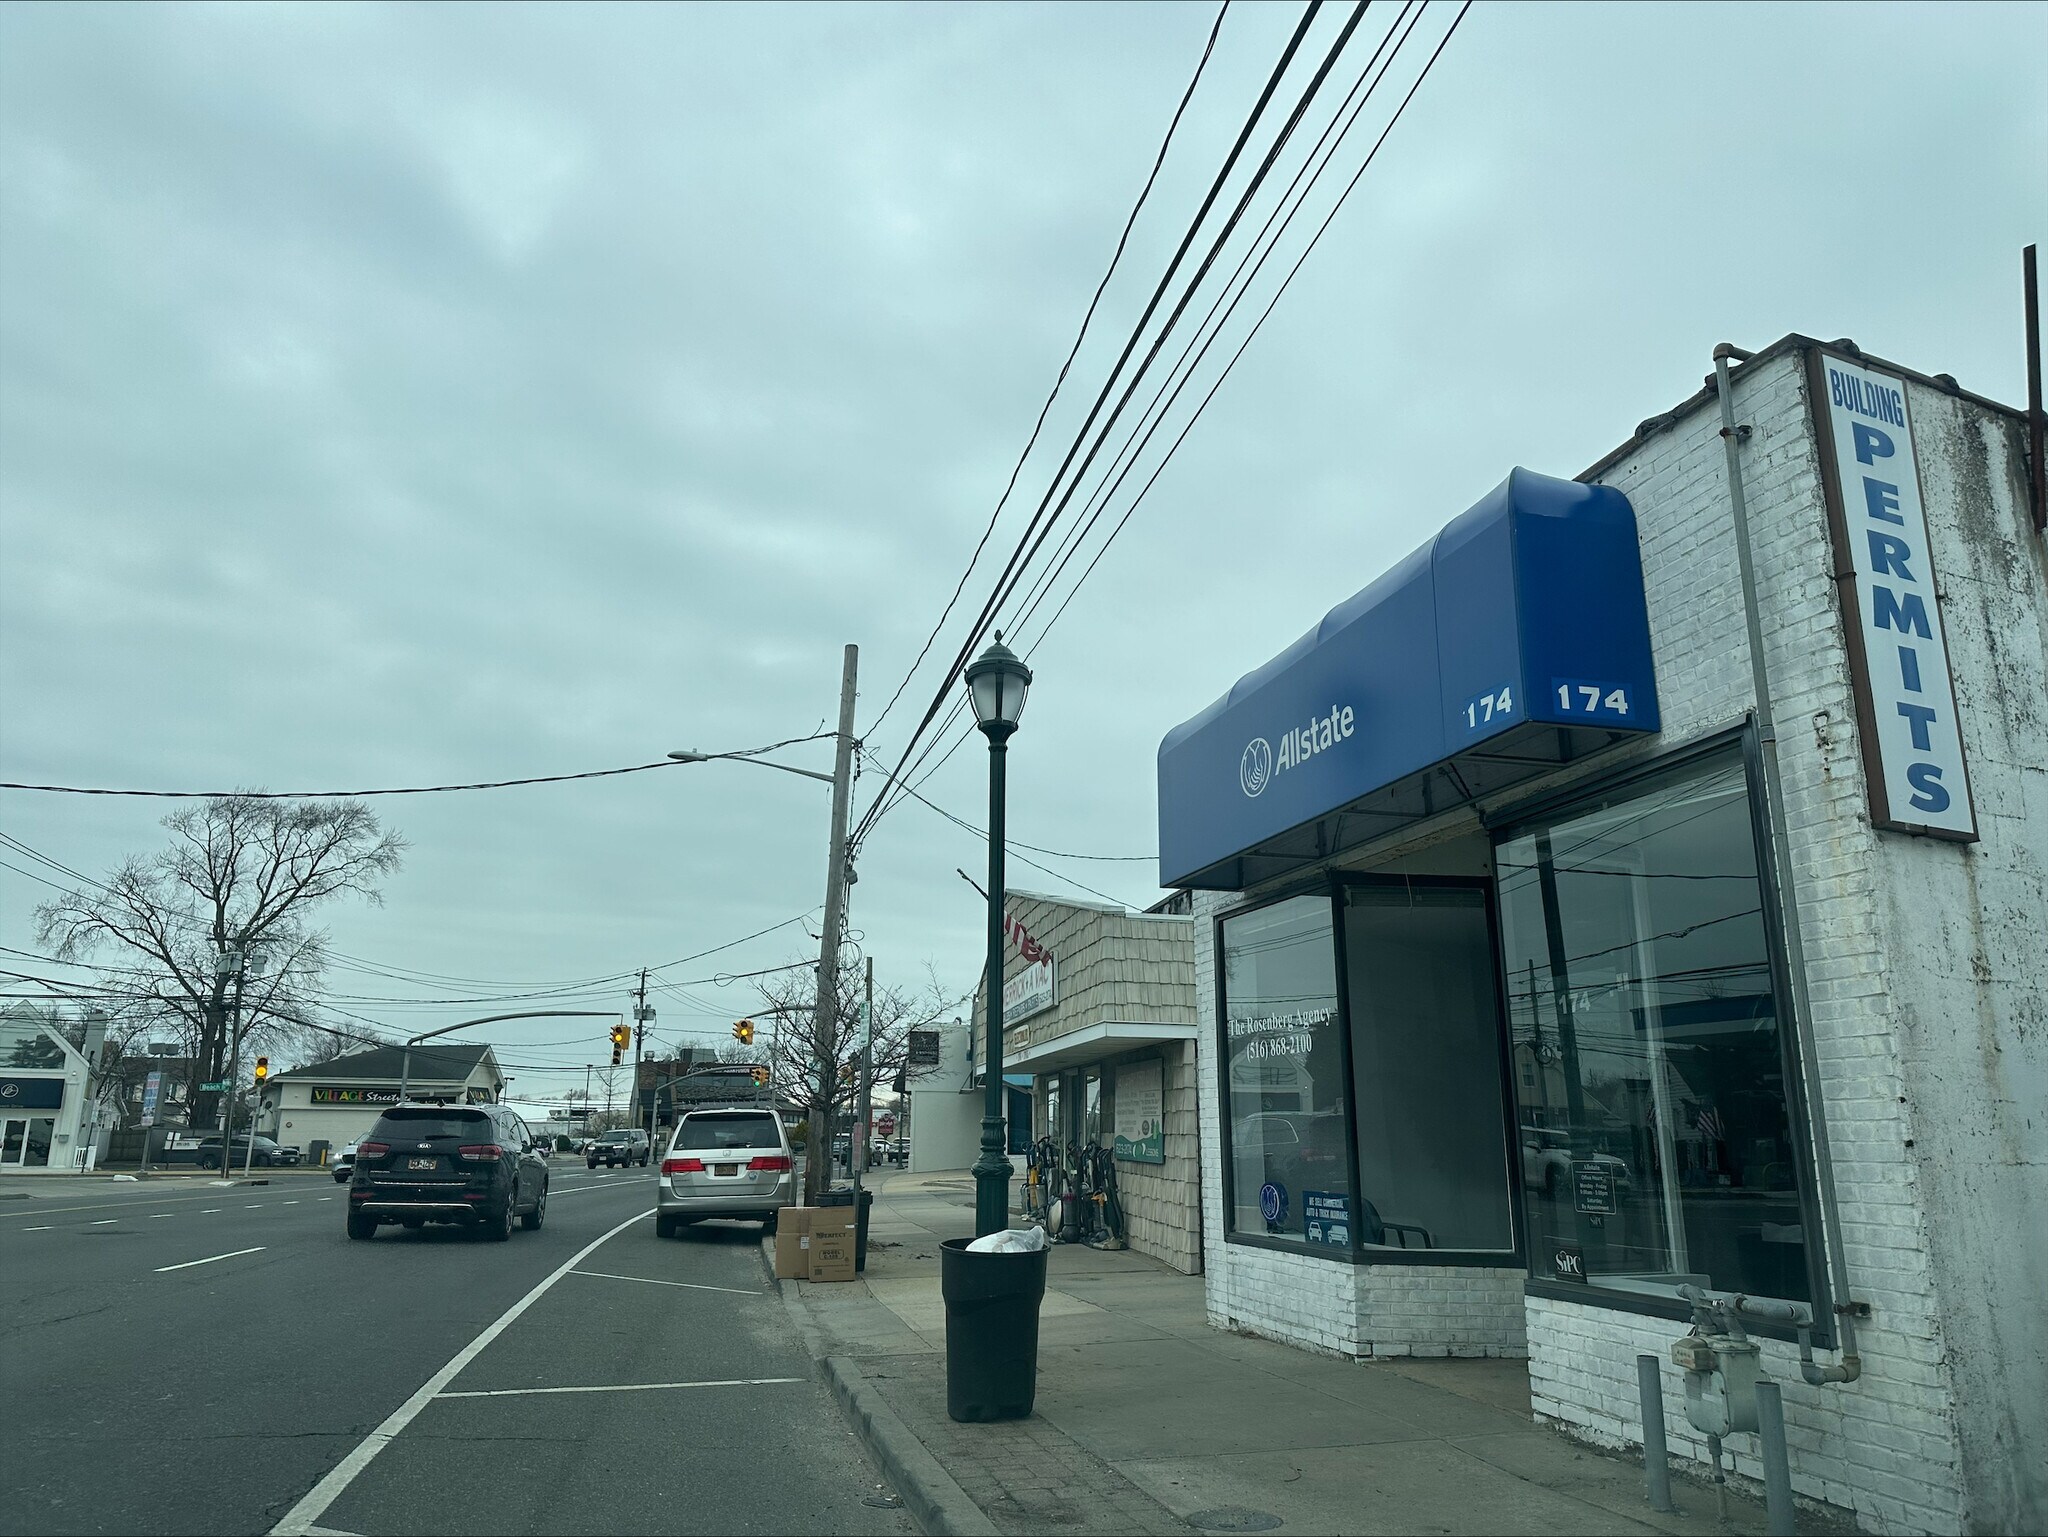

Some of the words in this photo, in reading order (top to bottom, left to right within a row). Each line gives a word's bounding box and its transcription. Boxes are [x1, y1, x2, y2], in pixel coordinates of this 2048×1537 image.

[1829, 367, 1905, 428] BUILDING
[1852, 421, 1951, 813] PERMITS
[1466, 686, 1513, 728] 174
[1556, 684, 1629, 715] 174
[1274, 703, 1356, 776] Allstate
[1558, 991, 1591, 1014] 174
[1229, 1019, 1245, 1036] The
[1247, 1012, 1293, 1032] Rosenberg
[1295, 1007, 1331, 1029] Agency
[1246, 1039, 1268, 1063] (516)
[1270, 1033, 1313, 1057] 868-2100
[314, 1089, 364, 1101] VILLAGE
